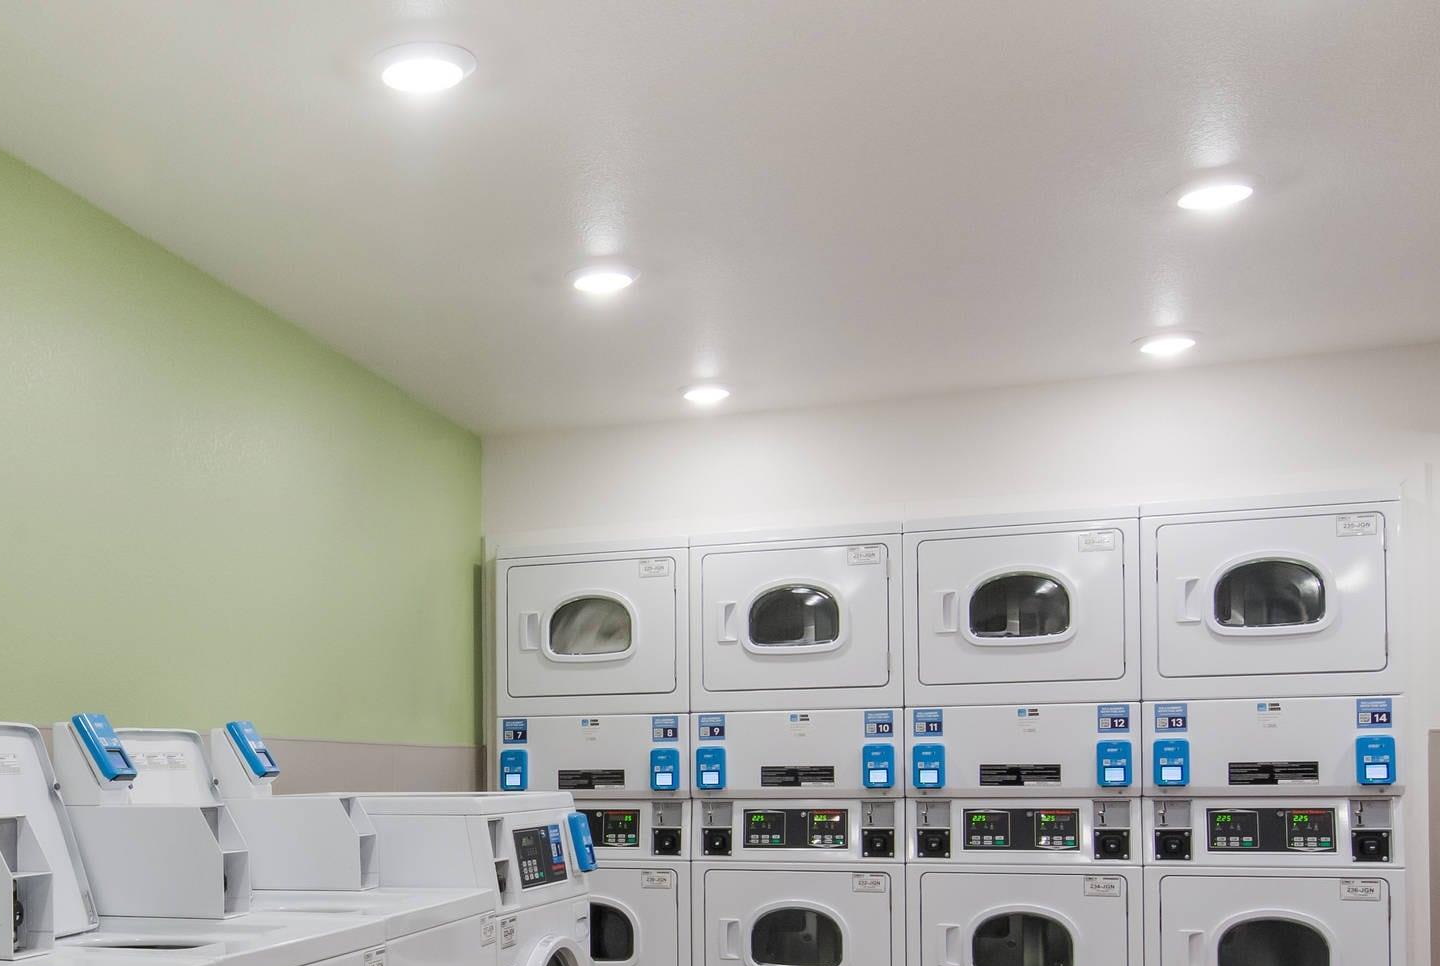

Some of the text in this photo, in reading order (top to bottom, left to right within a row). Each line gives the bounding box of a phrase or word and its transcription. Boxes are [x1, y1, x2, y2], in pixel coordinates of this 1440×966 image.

[1374, 714, 1387, 722] 14
[929, 723, 938, 731] 11
[1114, 719, 1124, 727] 12
[1171, 719, 1183, 727] 13
[879, 724, 889, 732] 10
